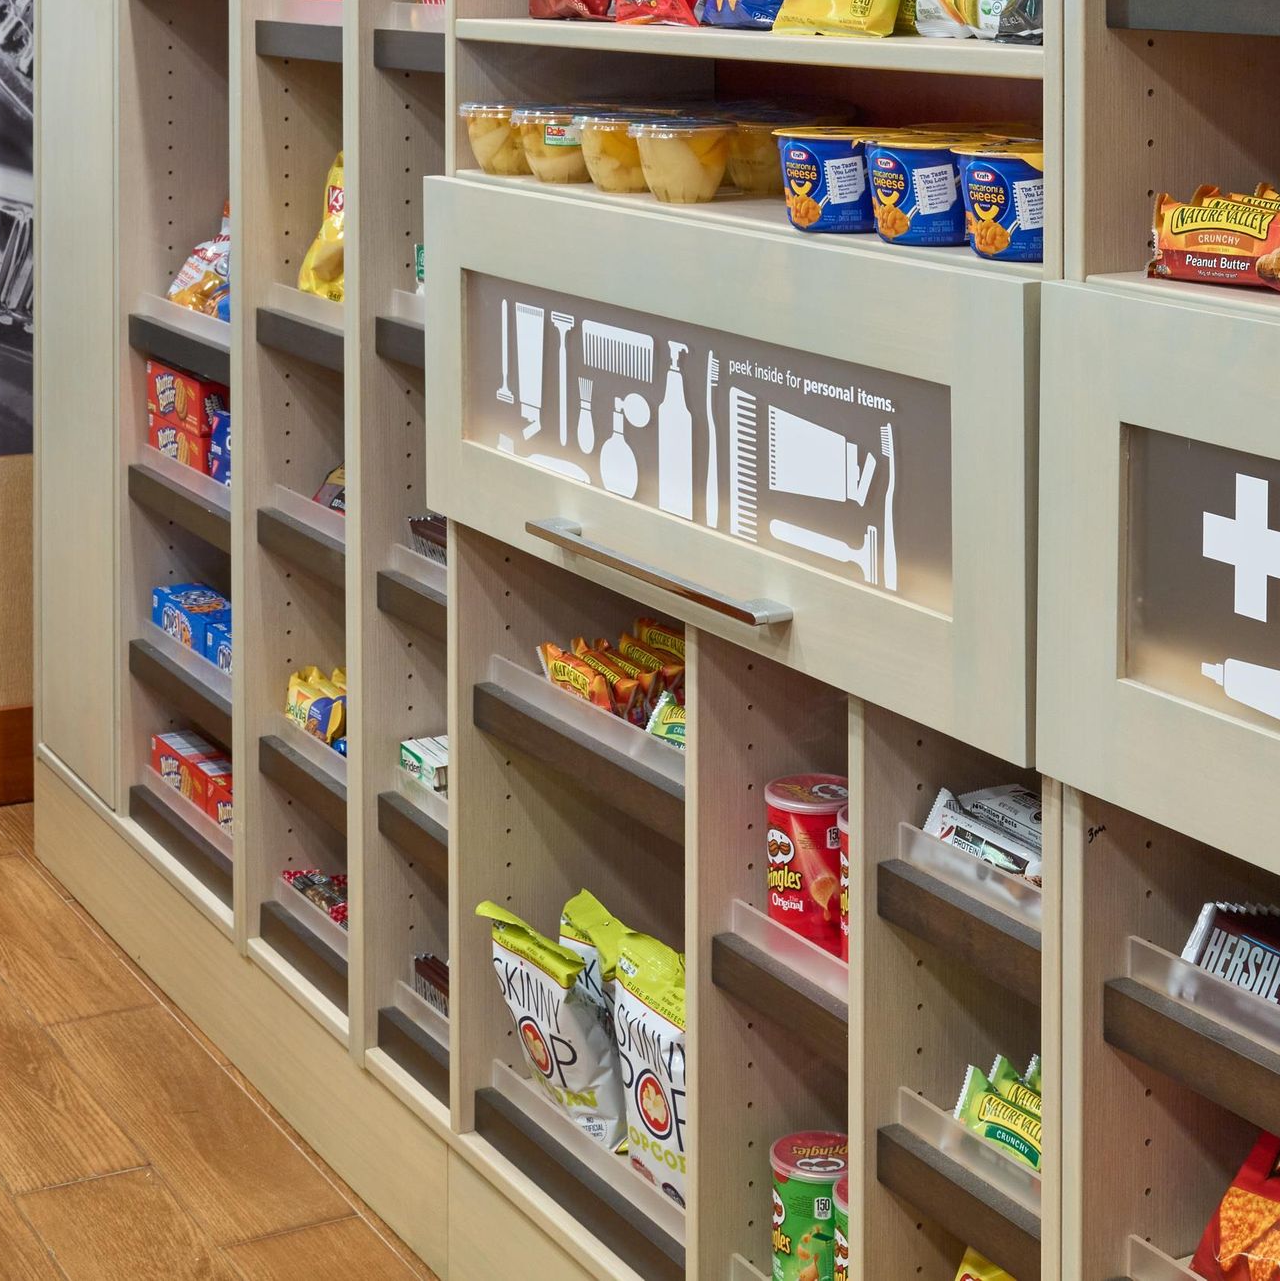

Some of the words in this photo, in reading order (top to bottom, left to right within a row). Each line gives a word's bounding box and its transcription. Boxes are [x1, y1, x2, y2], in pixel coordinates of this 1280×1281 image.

[546, 126, 566, 136] Dole
[842, 161, 857, 169] Taste
[931, 170, 948, 178] Taste
[1176, 208, 1224, 229] NATURE
[1225, 210, 1266, 236] VALLEY
[1198, 234, 1241, 246] CRUNCHY
[1185, 254, 1217, 269] Peanut
[1220, 257, 1251, 271] Butter
[729, 360, 753, 377] peek
[754, 362, 784, 385] inside
[786, 370, 802, 389] for
[803, 378, 854, 403] personal
[857, 388, 896, 413] items.
[1001, 815, 1018, 828] Facts
[954, 837, 980, 856] PROTEIN
[767, 865, 802, 892] ingles
[772, 892, 804, 913] Original
[492, 958, 561, 1034] SKINNY
[1012, 1085, 1041, 1111] NATUR
[983, 1096, 1020, 1130] NATURE
[1020, 1117, 1041, 1142] VALL
[996, 1129, 1030, 1155] CRUNCHY
[816, 1198, 830, 1211] 150
